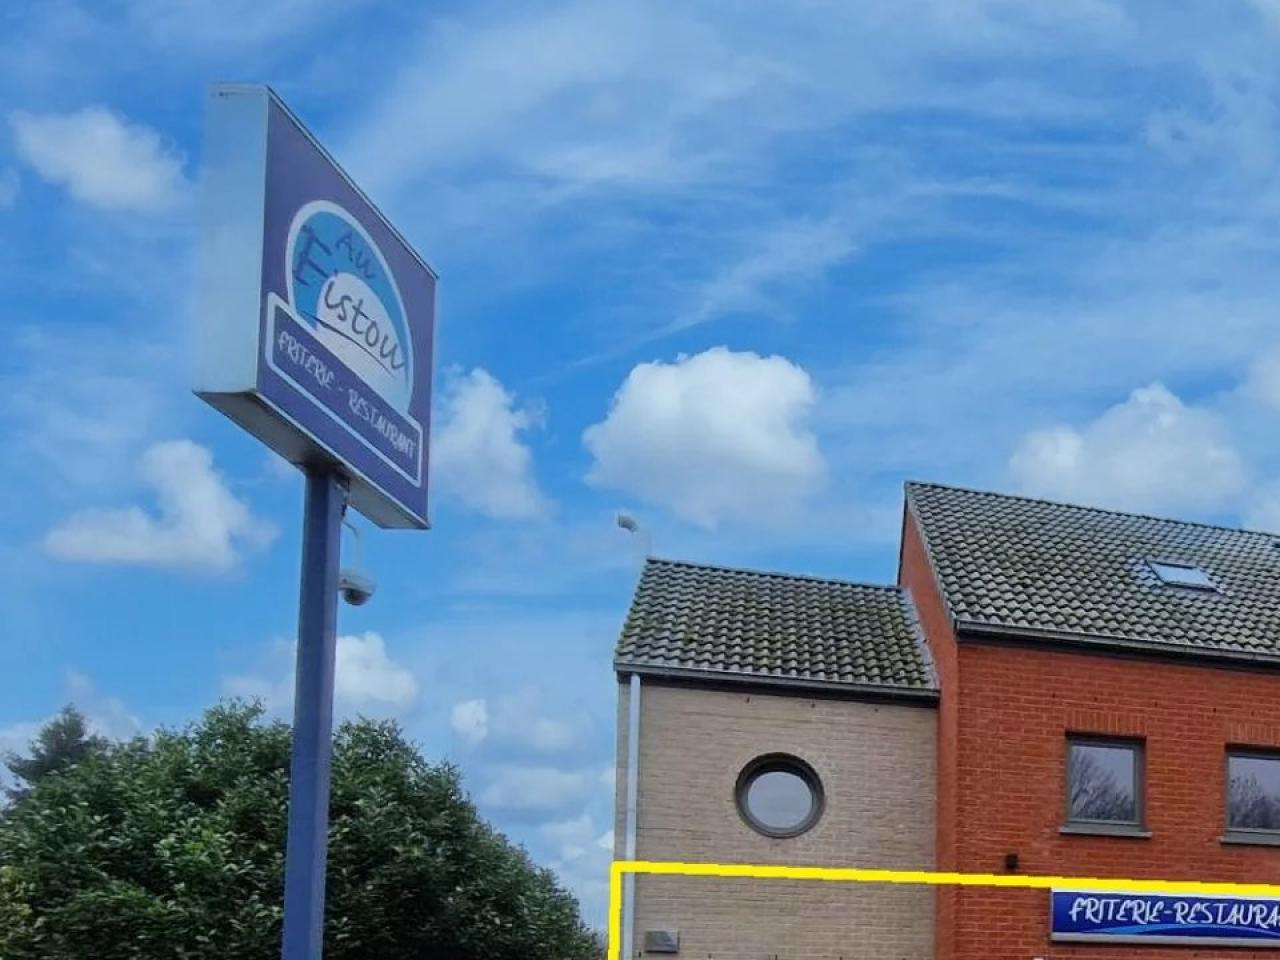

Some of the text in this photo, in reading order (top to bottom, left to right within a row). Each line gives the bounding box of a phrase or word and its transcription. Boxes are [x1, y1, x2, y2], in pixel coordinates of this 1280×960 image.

[335, 230, 377, 280] Au
[278, 330, 335, 391] FRITERIE
[348, 387, 417, 460] RESTAURANT
